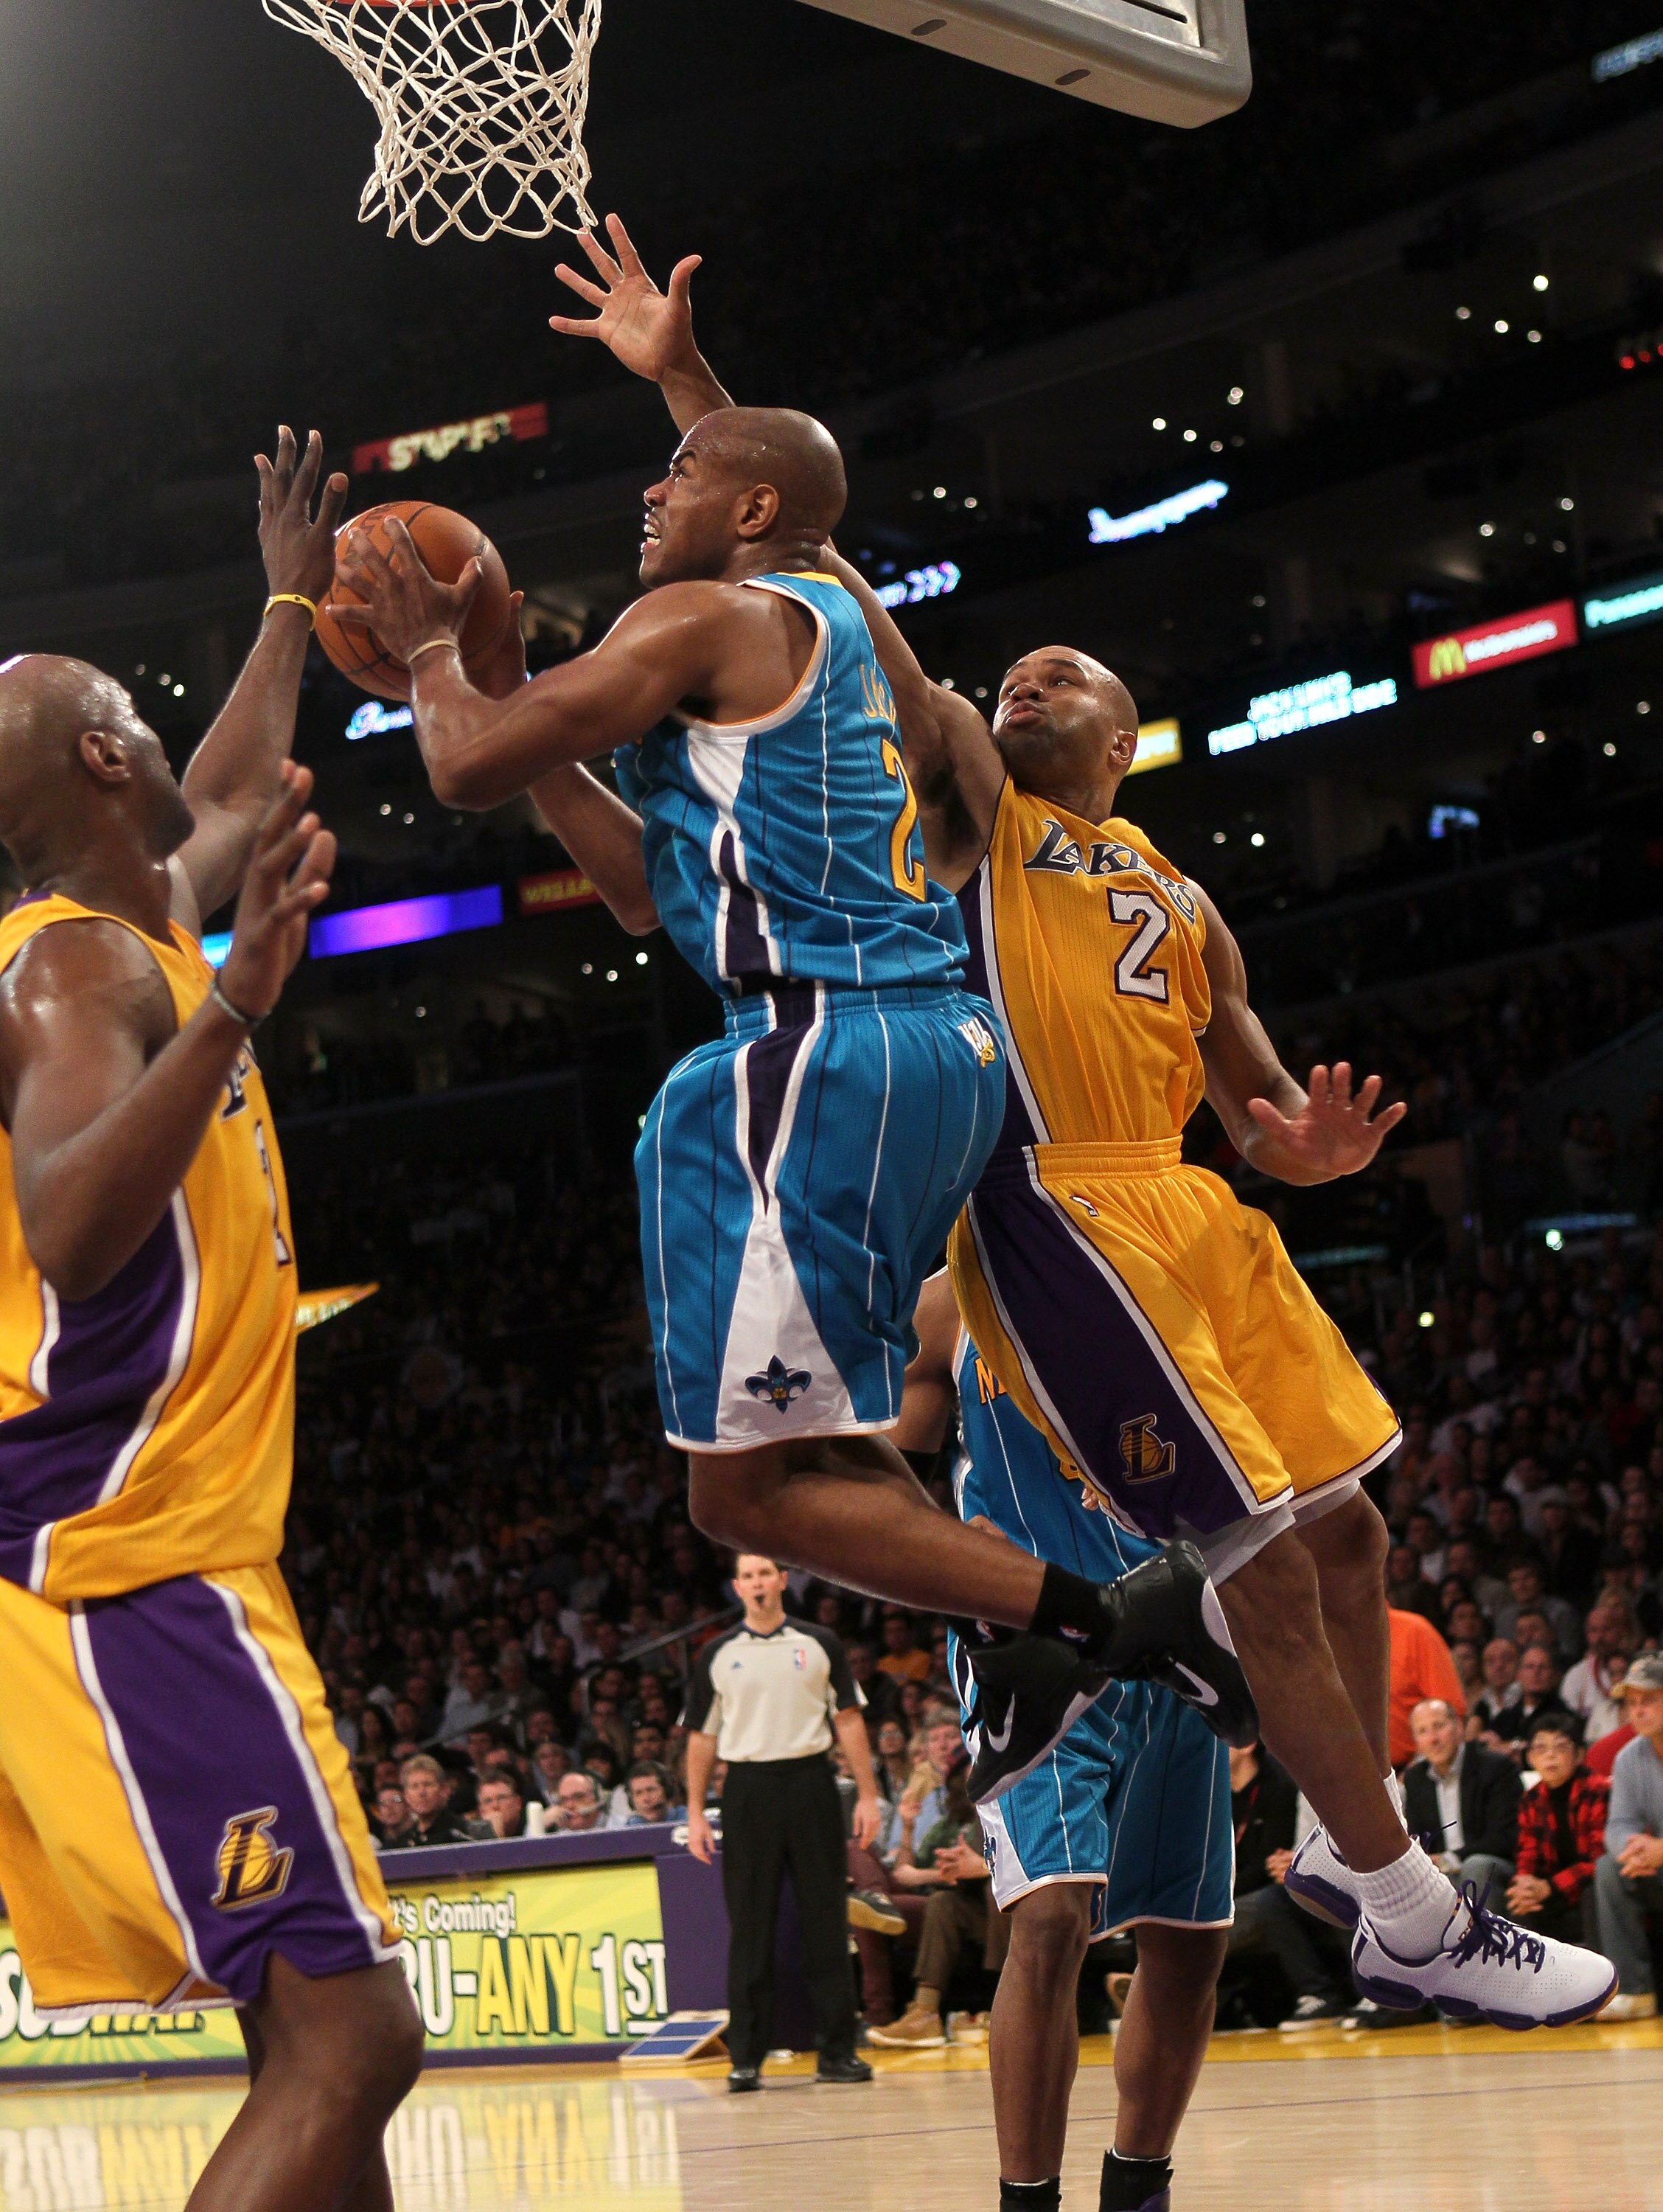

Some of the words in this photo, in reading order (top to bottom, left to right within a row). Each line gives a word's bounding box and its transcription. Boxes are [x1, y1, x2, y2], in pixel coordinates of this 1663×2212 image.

[879, 737, 928, 908] 2
[1106, 886, 1171, 1004] 2
[422, 1891, 516, 1939] Coming!
